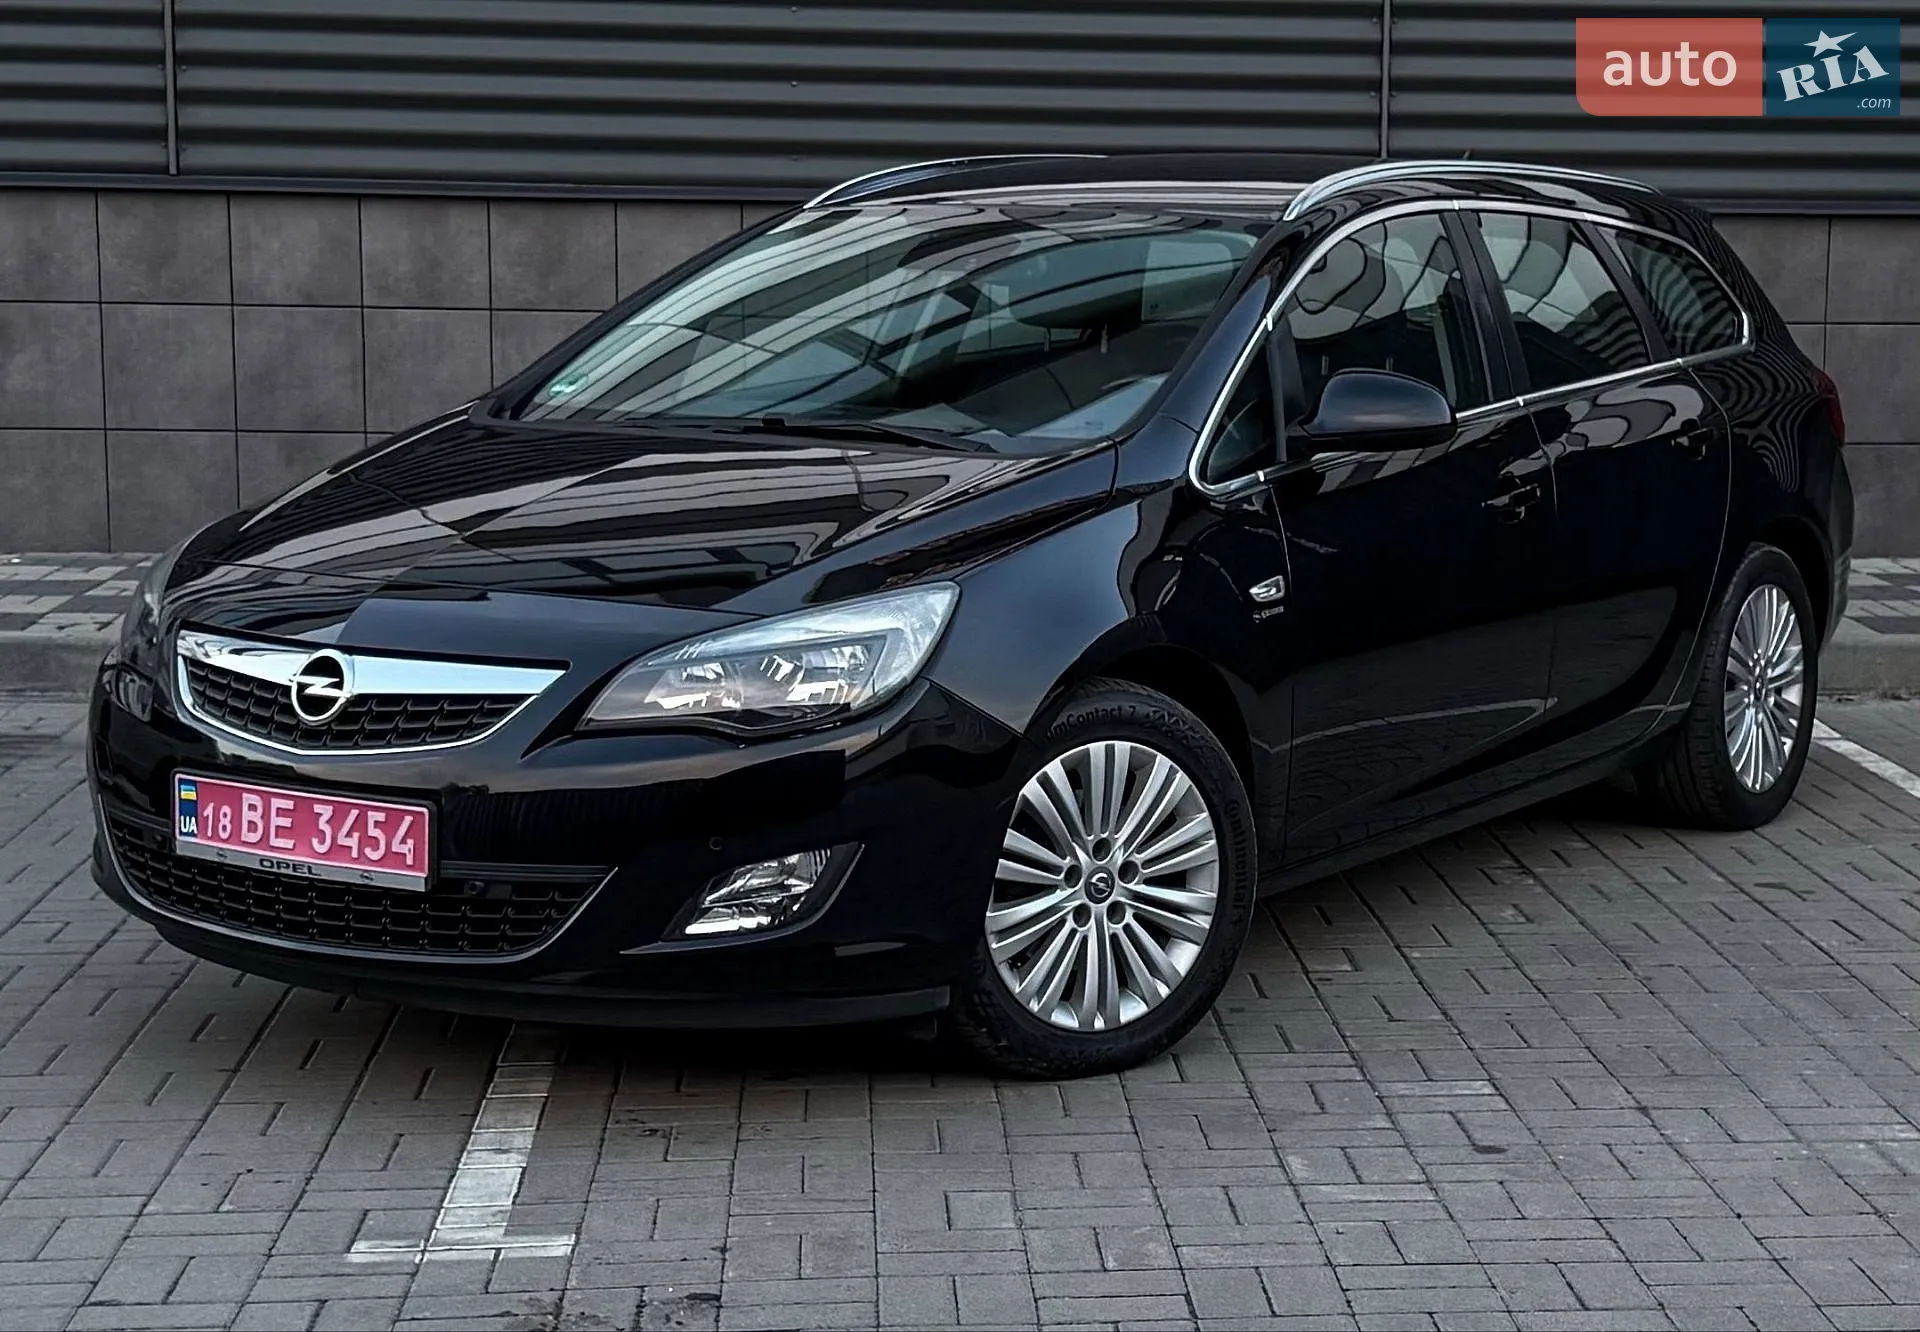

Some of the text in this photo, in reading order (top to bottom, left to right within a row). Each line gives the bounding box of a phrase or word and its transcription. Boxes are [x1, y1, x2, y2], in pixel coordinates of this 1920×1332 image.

[180, 815, 197, 834] UA
[203, 792, 414, 866] 18 BE 3454
[259, 858, 322, 877] OPEL
